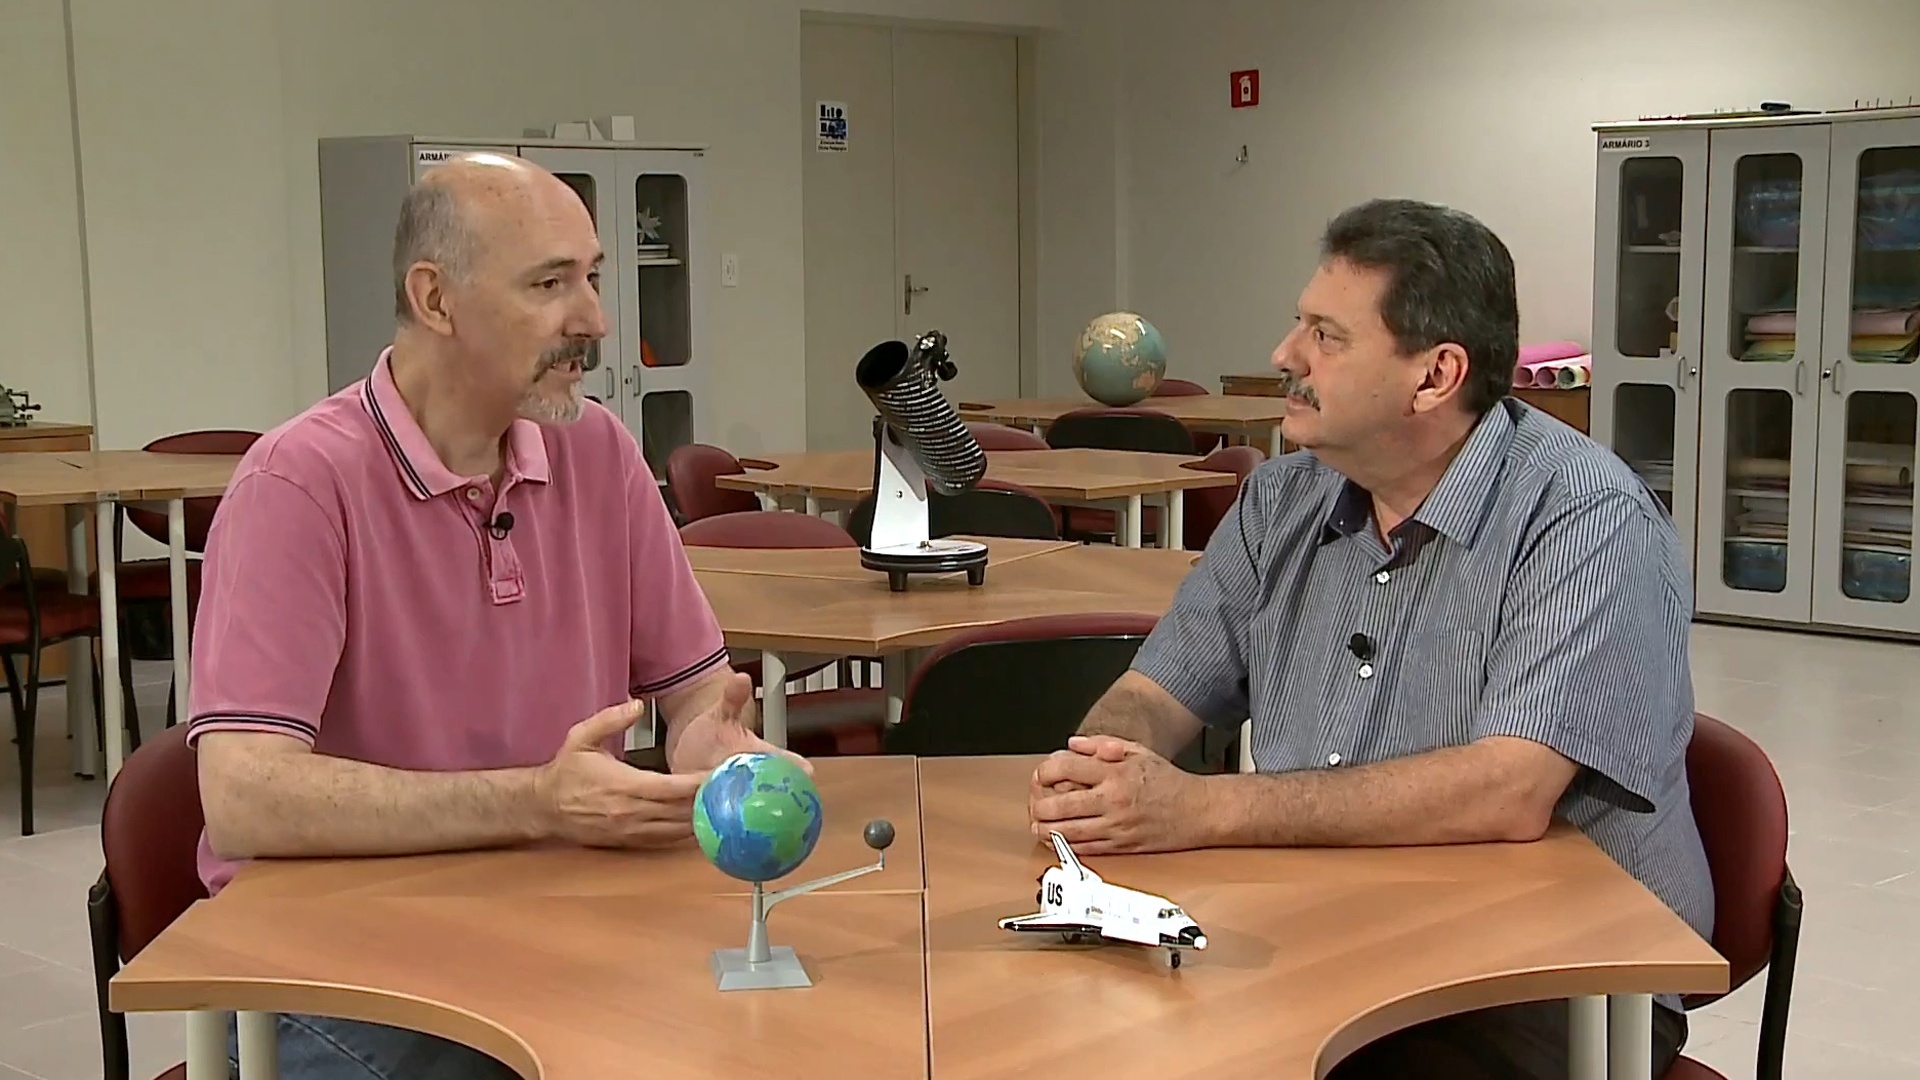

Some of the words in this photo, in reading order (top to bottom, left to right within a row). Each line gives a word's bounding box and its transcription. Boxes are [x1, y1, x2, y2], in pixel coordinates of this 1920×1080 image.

[1602, 139, 1643, 149] ARMÁRIO
[1645, 139, 1650, 148] 3
[419, 151, 450, 161] ARMÁR
[1047, 881, 1063, 907] US
